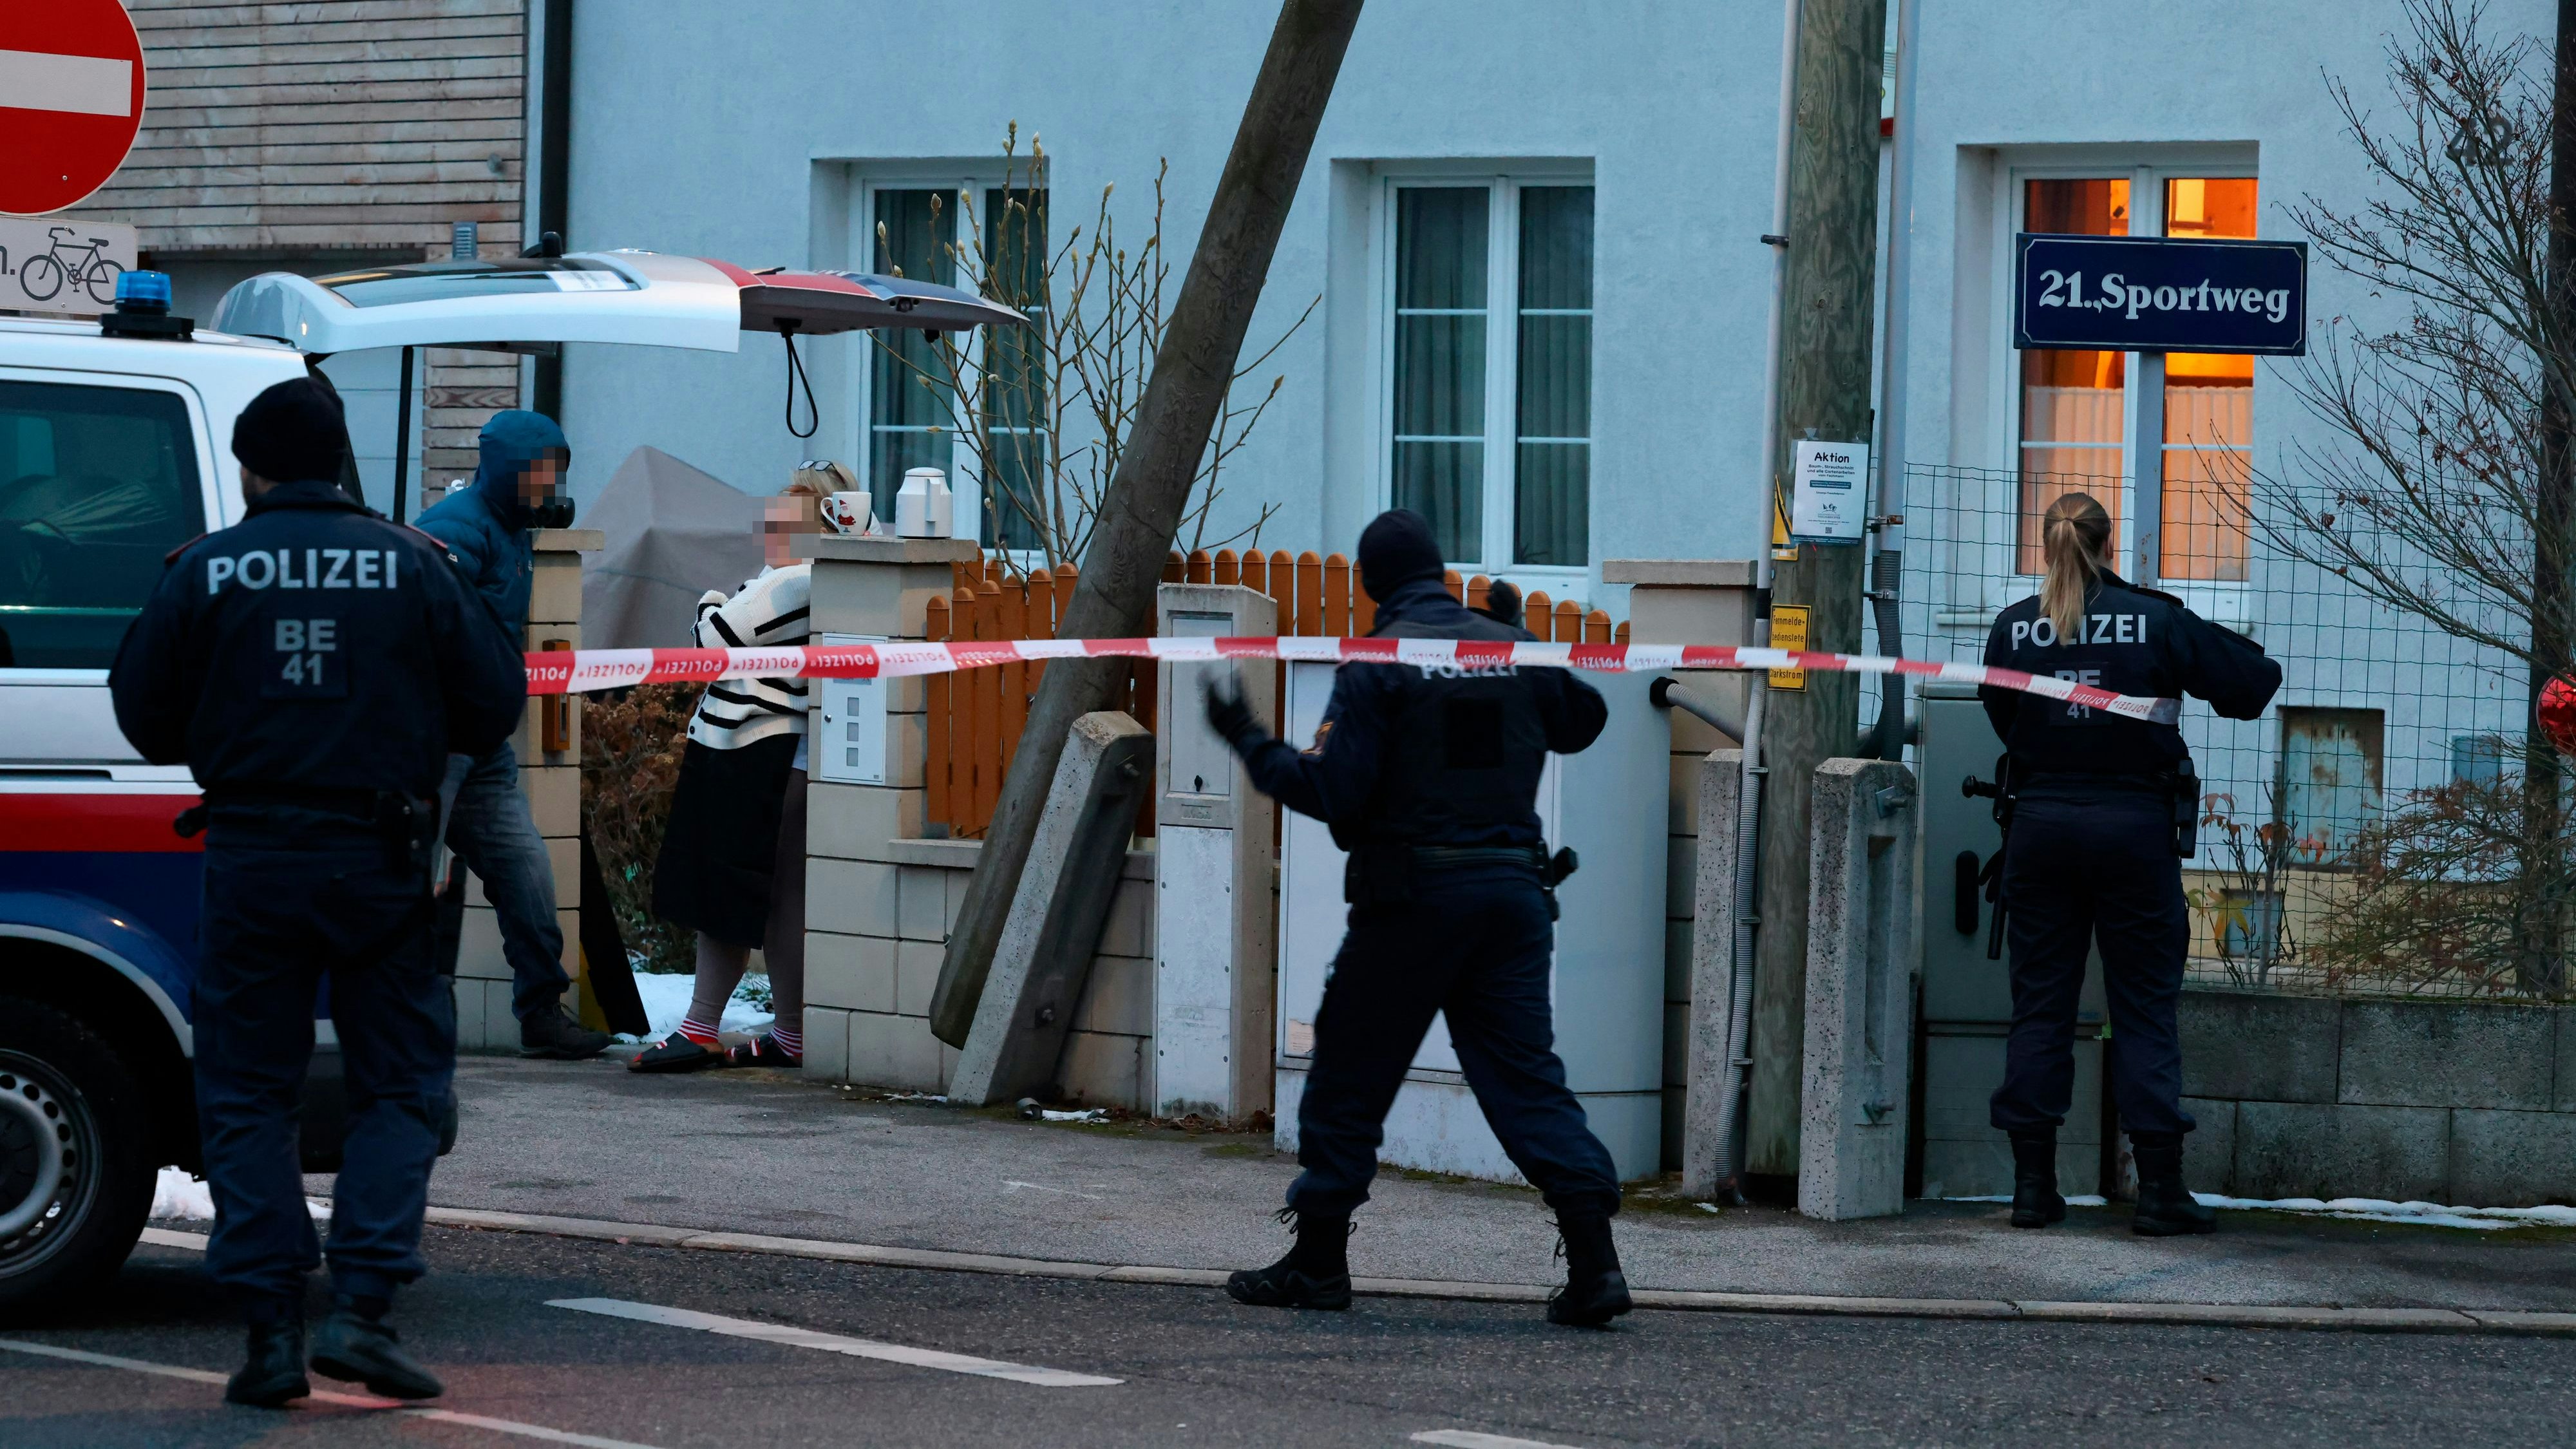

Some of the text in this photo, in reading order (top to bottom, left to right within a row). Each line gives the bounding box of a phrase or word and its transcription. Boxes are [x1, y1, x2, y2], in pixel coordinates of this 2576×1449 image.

[1814, 452, 1850, 463] Aktion
[208, 549, 397, 594] POLIZEI
[275, 620, 336, 651] BE
[281, 654, 322, 685] 41
[525, 667, 567, 681] POLIZ
